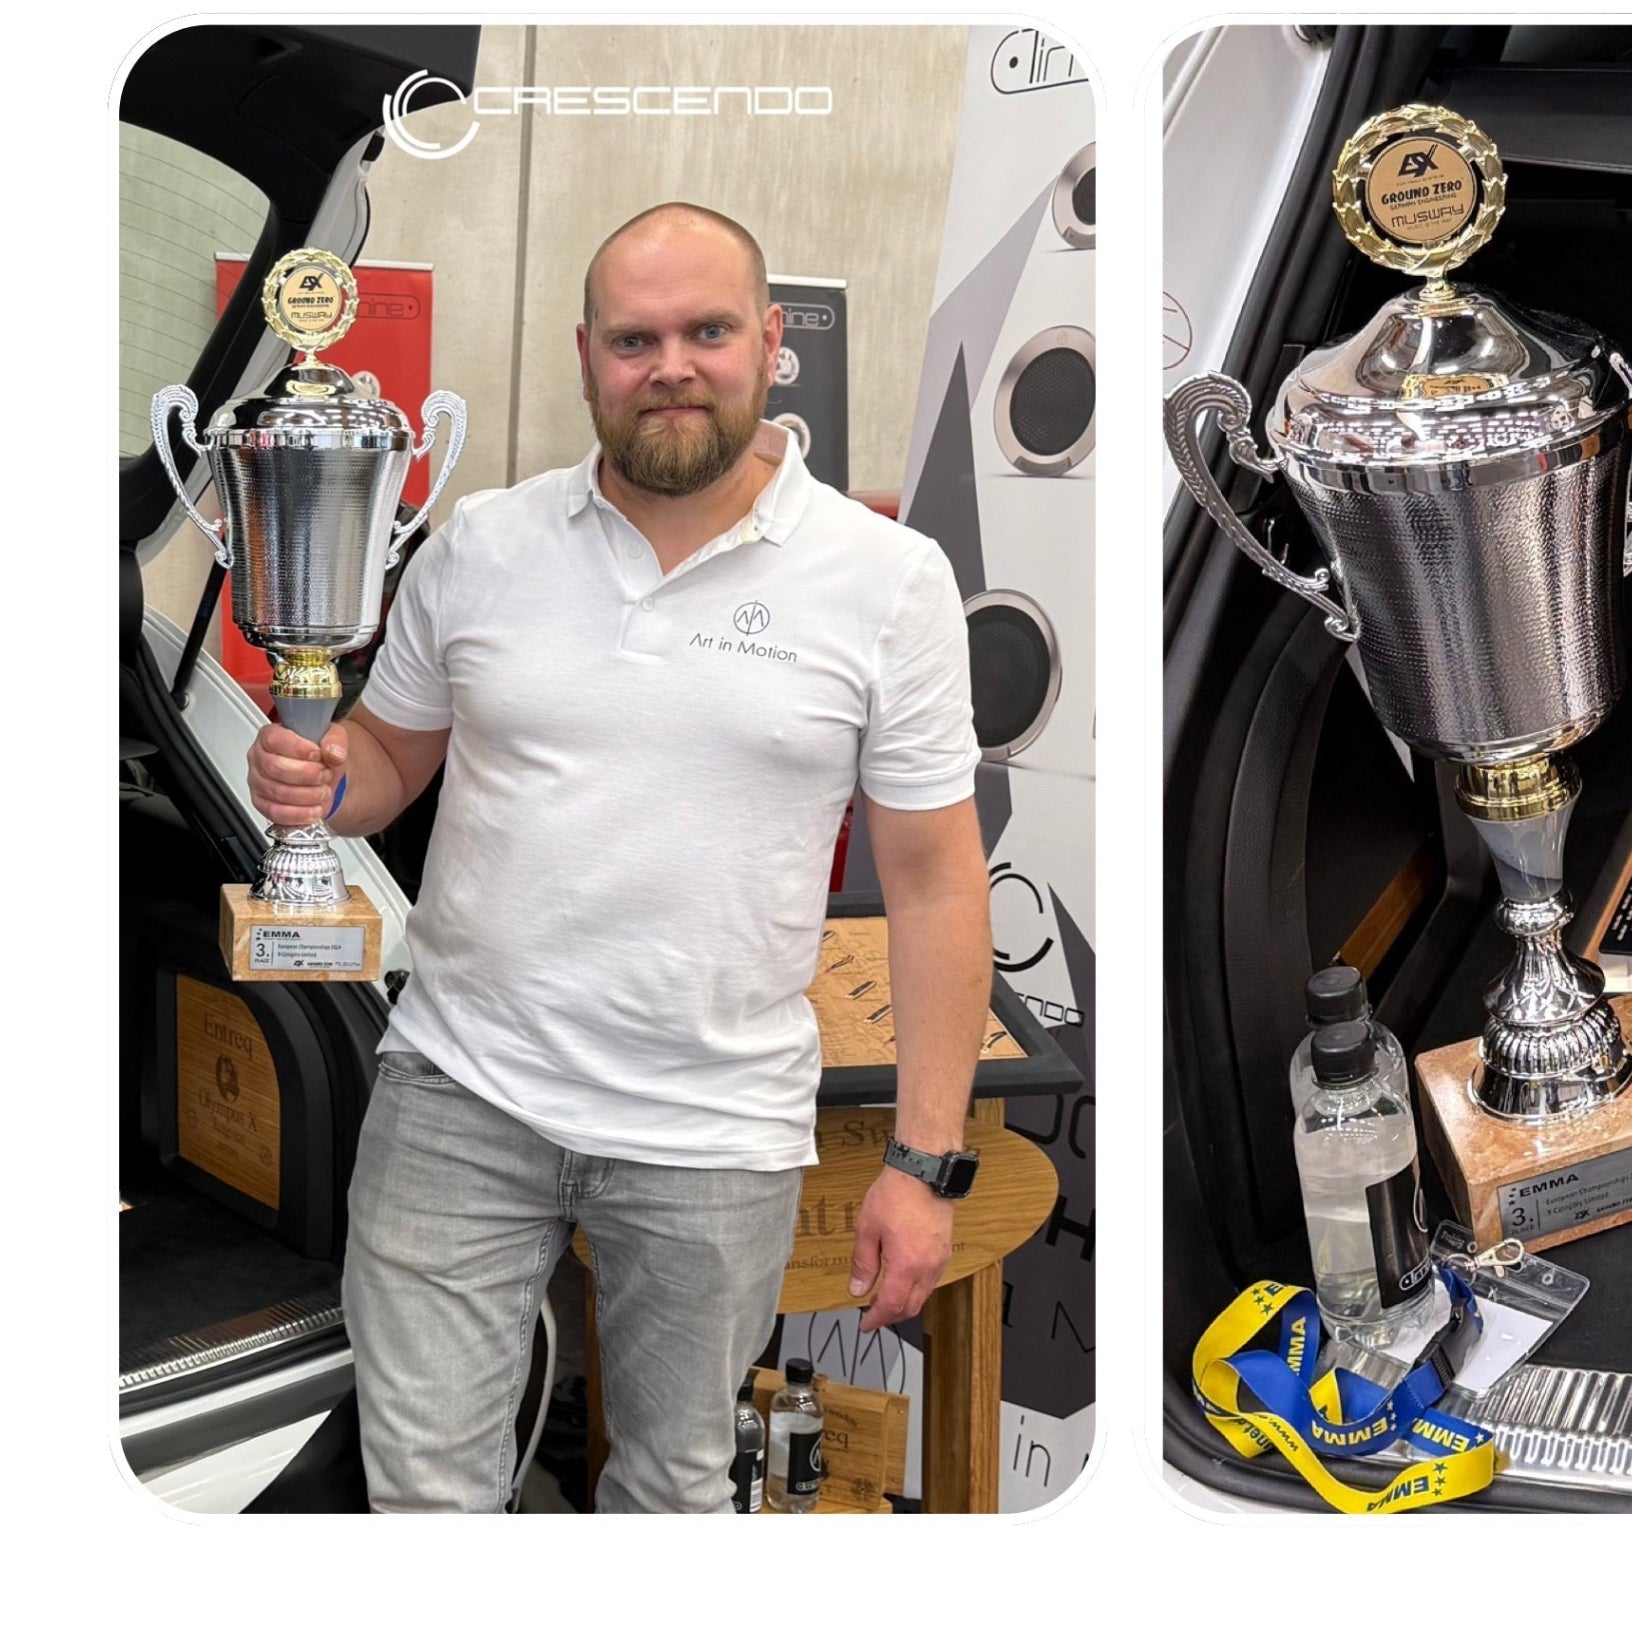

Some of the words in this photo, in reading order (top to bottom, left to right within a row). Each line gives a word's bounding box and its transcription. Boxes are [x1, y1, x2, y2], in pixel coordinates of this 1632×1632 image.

[1381, 186, 1430, 205] GROUND
[1433, 180, 1463, 196] ZERO
[1391, 203, 1465, 229] MUSWAY
[288, 297, 315, 305] GROUND
[317, 296, 334, 304] ZERO
[689, 632, 713, 649] Art
[718, 636, 732, 652] in
[737, 640, 798, 663] Motion
[263, 930, 301, 938] EMMA
[255, 942, 270, 958] 3.
[1519, 1173, 1579, 1198] EMMA
[1511, 1207, 1535, 1227] 3.
[1287, 1316, 1307, 1376] MMA
[1311, 1415, 1389, 1448] EMMA
[1412, 1418, 1470, 1452] EMM
